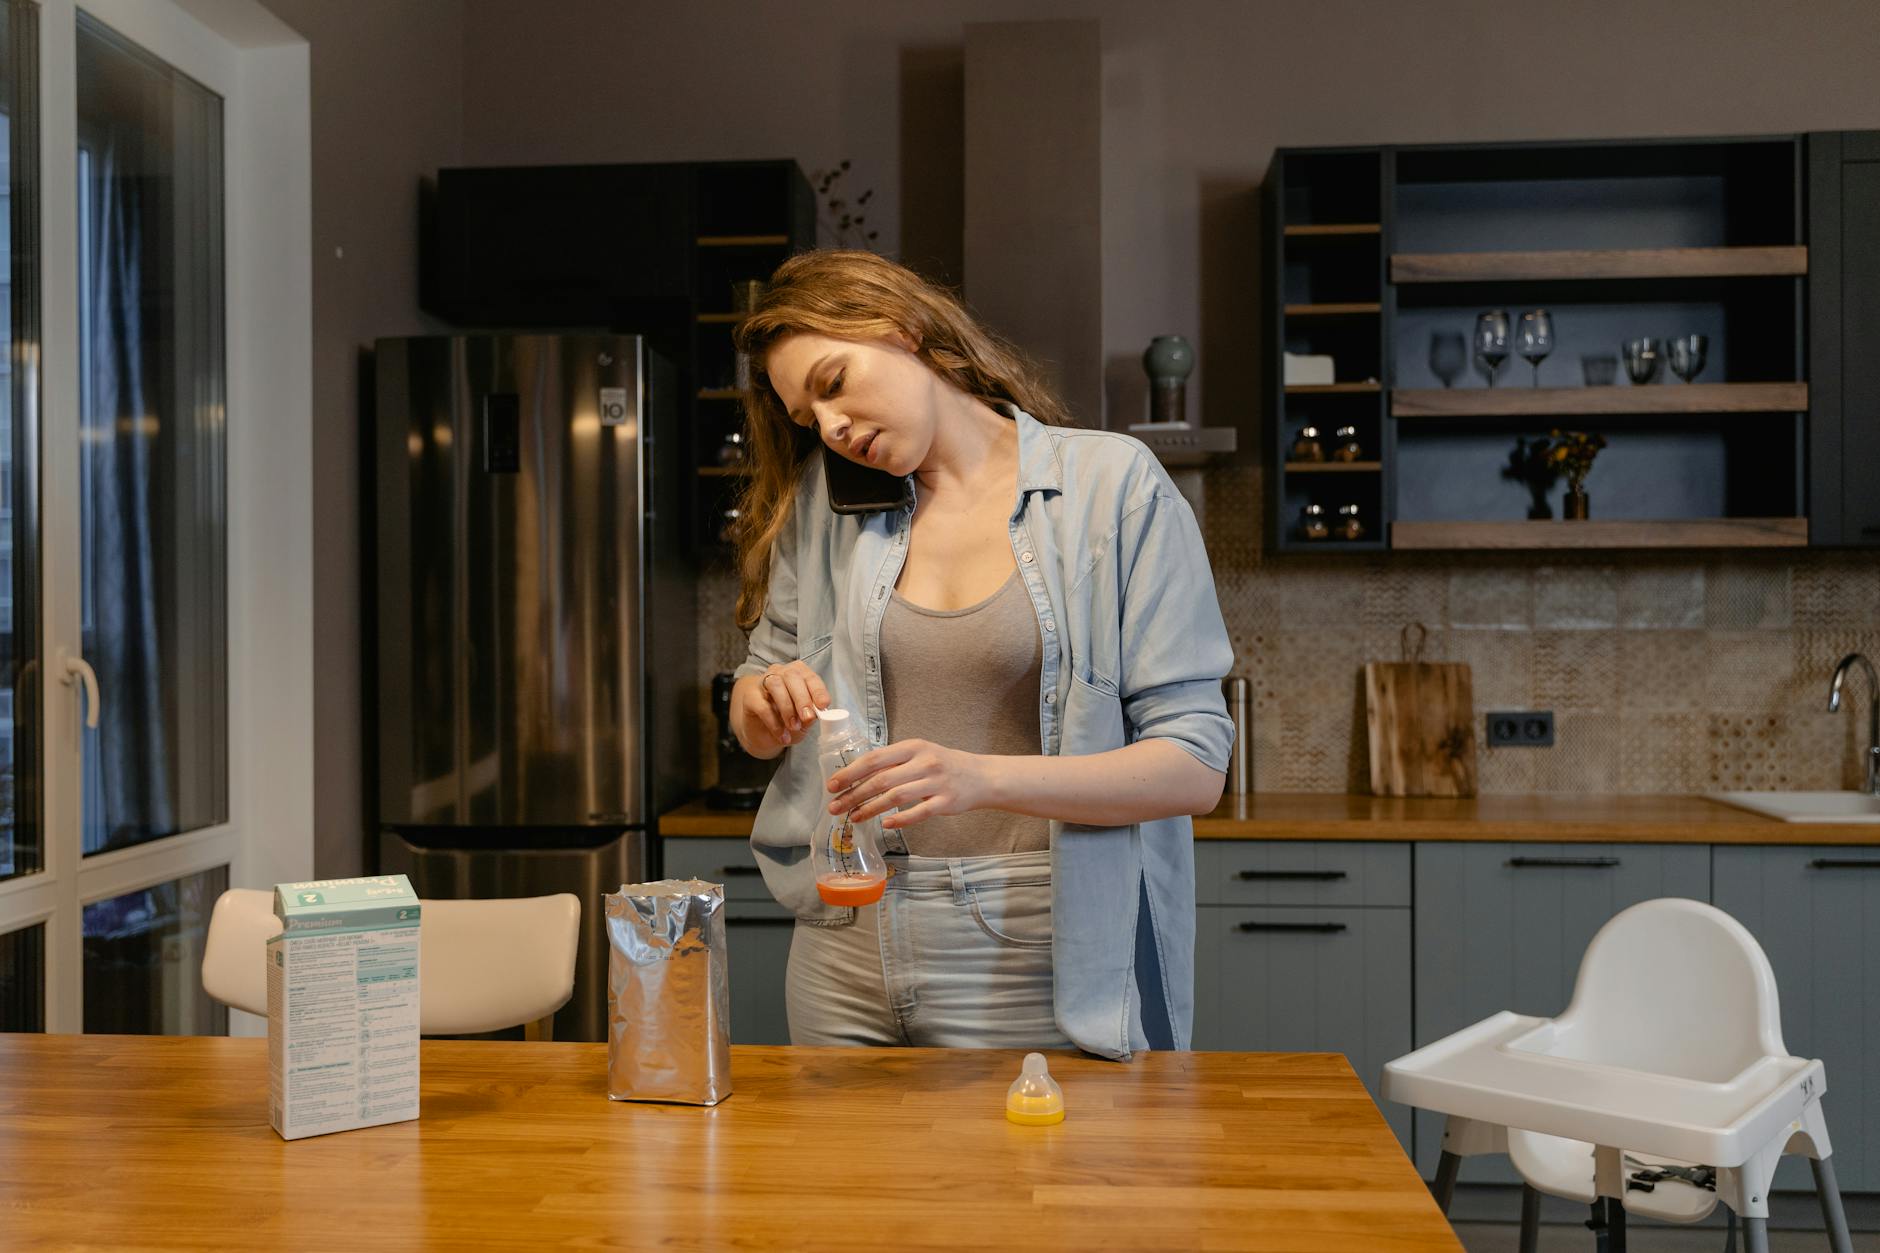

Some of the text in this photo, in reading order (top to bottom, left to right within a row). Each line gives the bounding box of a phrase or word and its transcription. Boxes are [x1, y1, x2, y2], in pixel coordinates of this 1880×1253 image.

[303, 894, 317, 903] 2
[399, 910, 408, 920] 2
[287, 917, 343, 931] Premium
